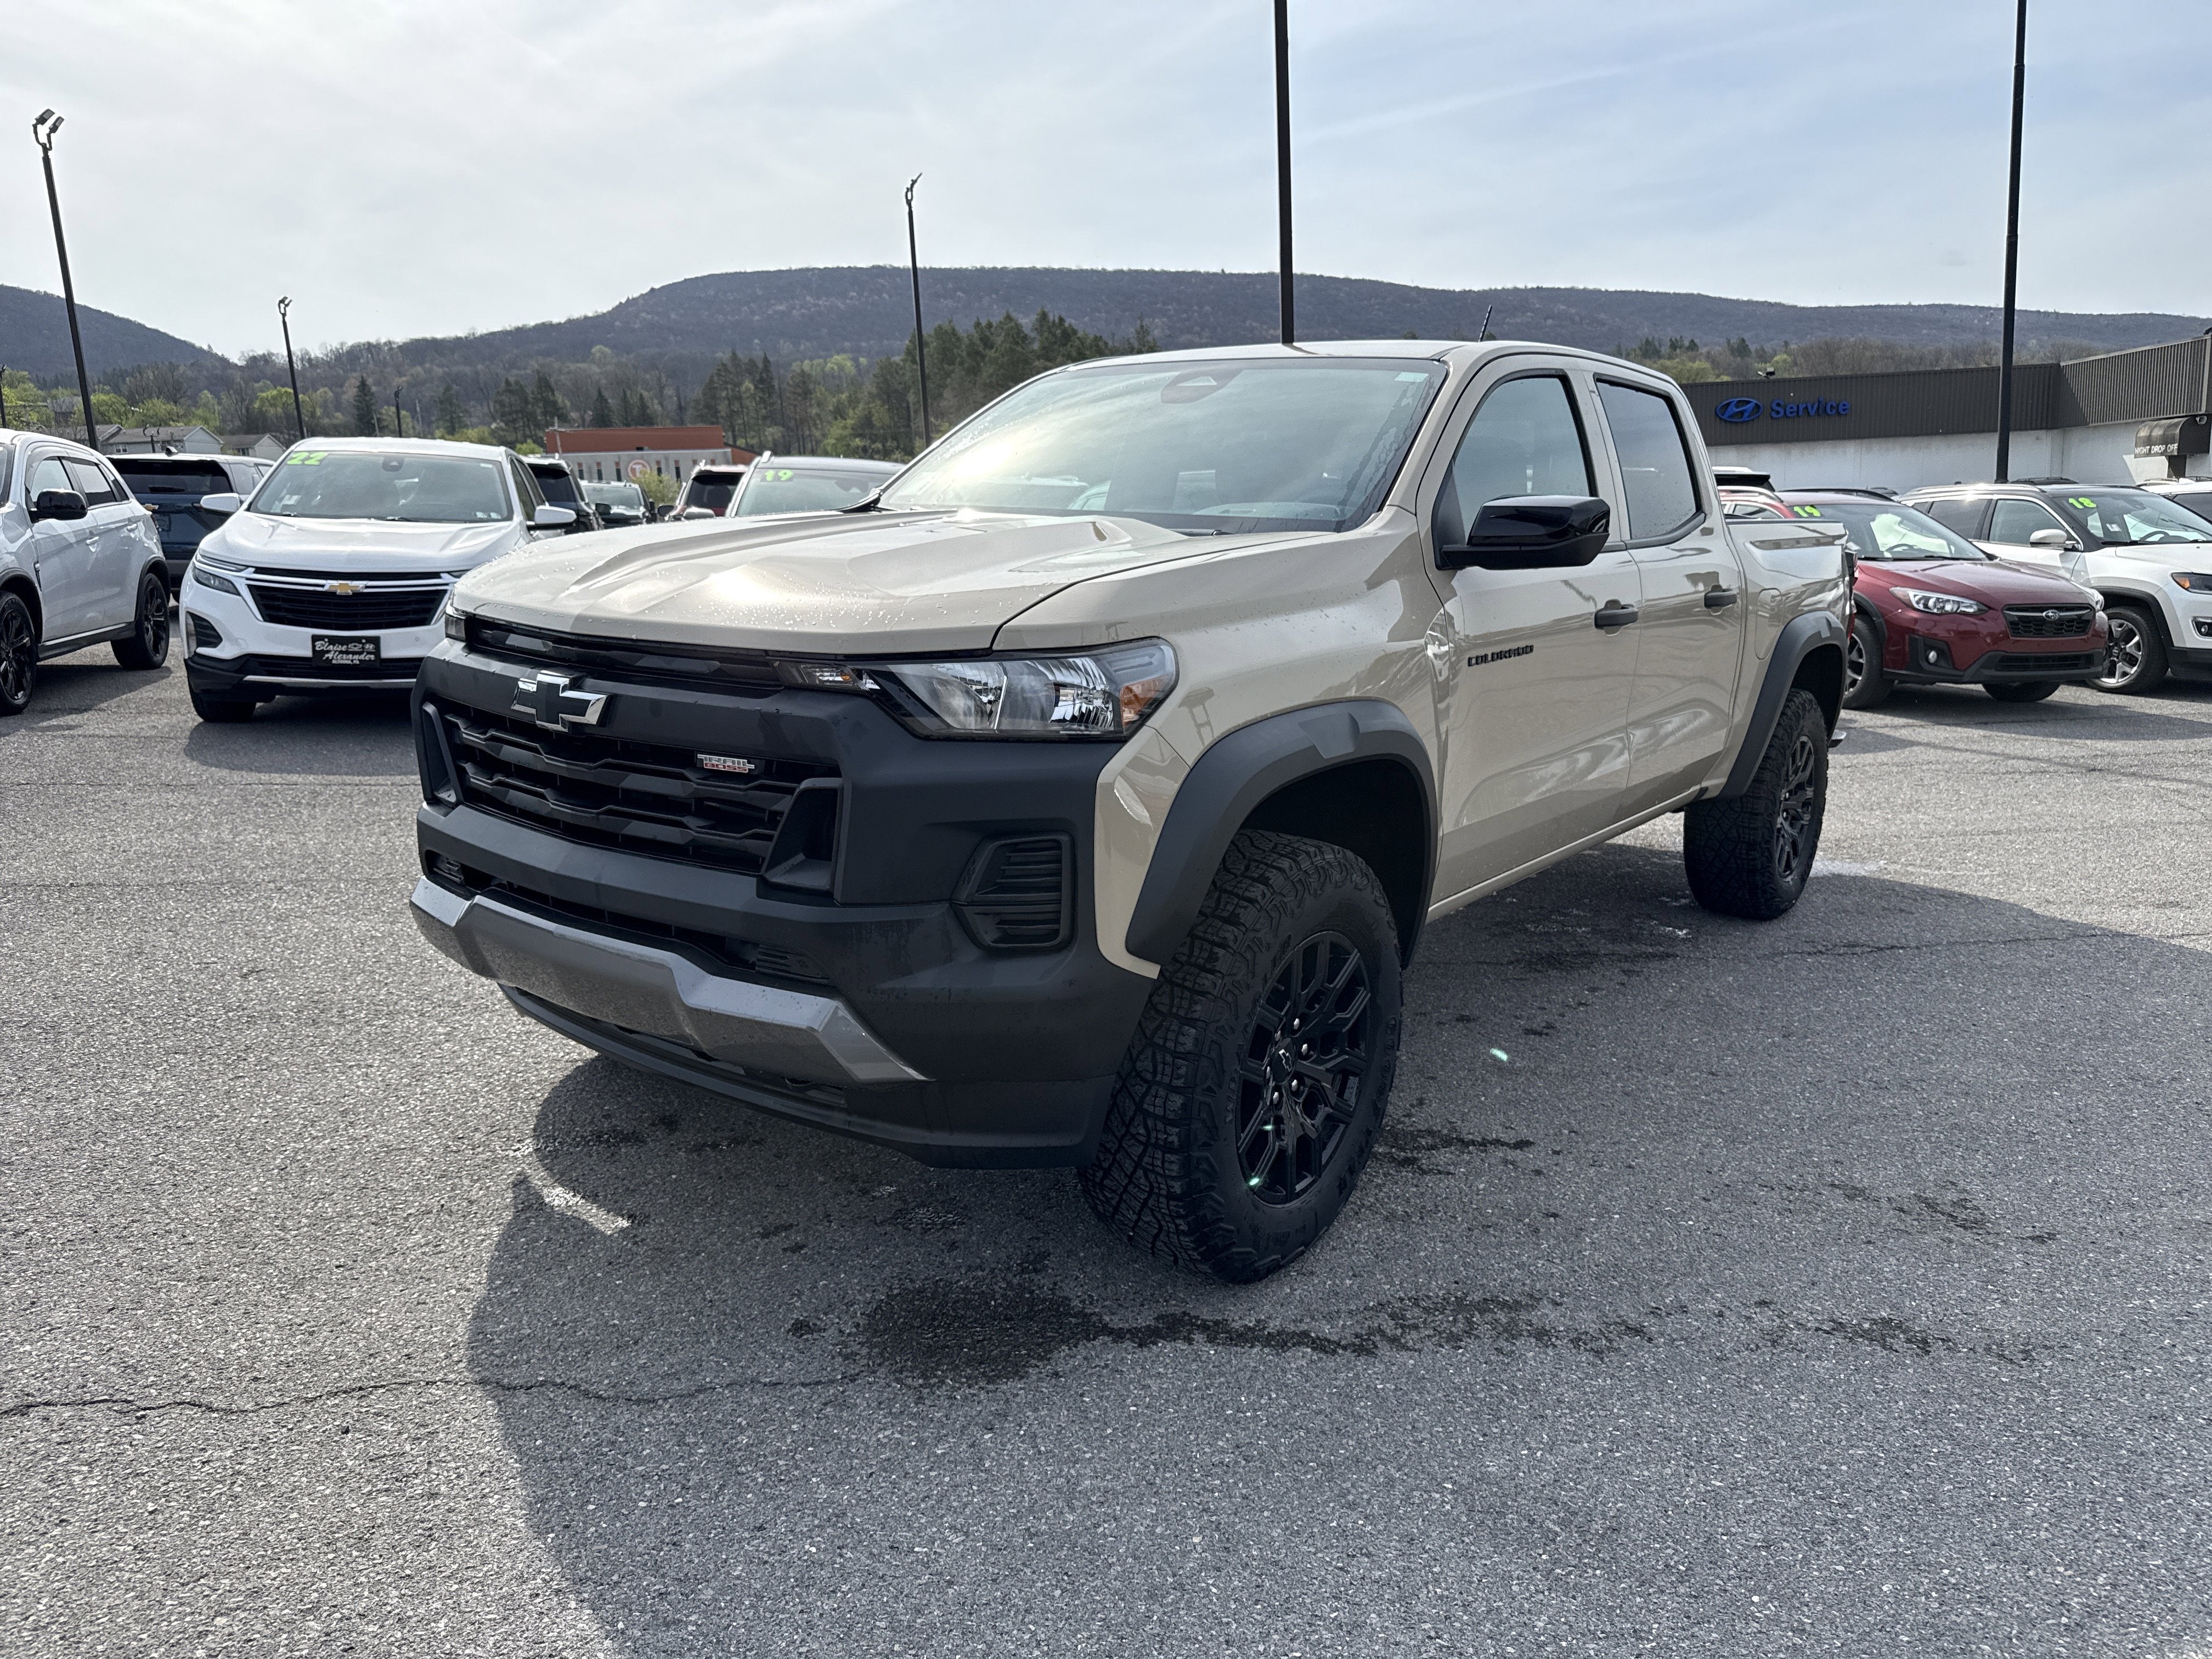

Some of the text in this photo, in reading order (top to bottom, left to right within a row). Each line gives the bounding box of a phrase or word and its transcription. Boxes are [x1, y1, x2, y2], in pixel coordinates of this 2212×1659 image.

[1770, 397, 1851, 419] Service
[2134, 443, 2178, 455] NIGHT DROP OFF
[287, 452, 328, 465] 22
[764, 469, 794, 482] 19
[2068, 497, 2097, 509] 18
[1793, 506, 1821, 517] 19
[315, 640, 348, 651] Blaise
[322, 650, 376, 661] Alexander
[1468, 645, 1534, 667] COLORADO
[697, 754, 755, 769] TRAIL
[704, 761, 749, 773] BOSS
